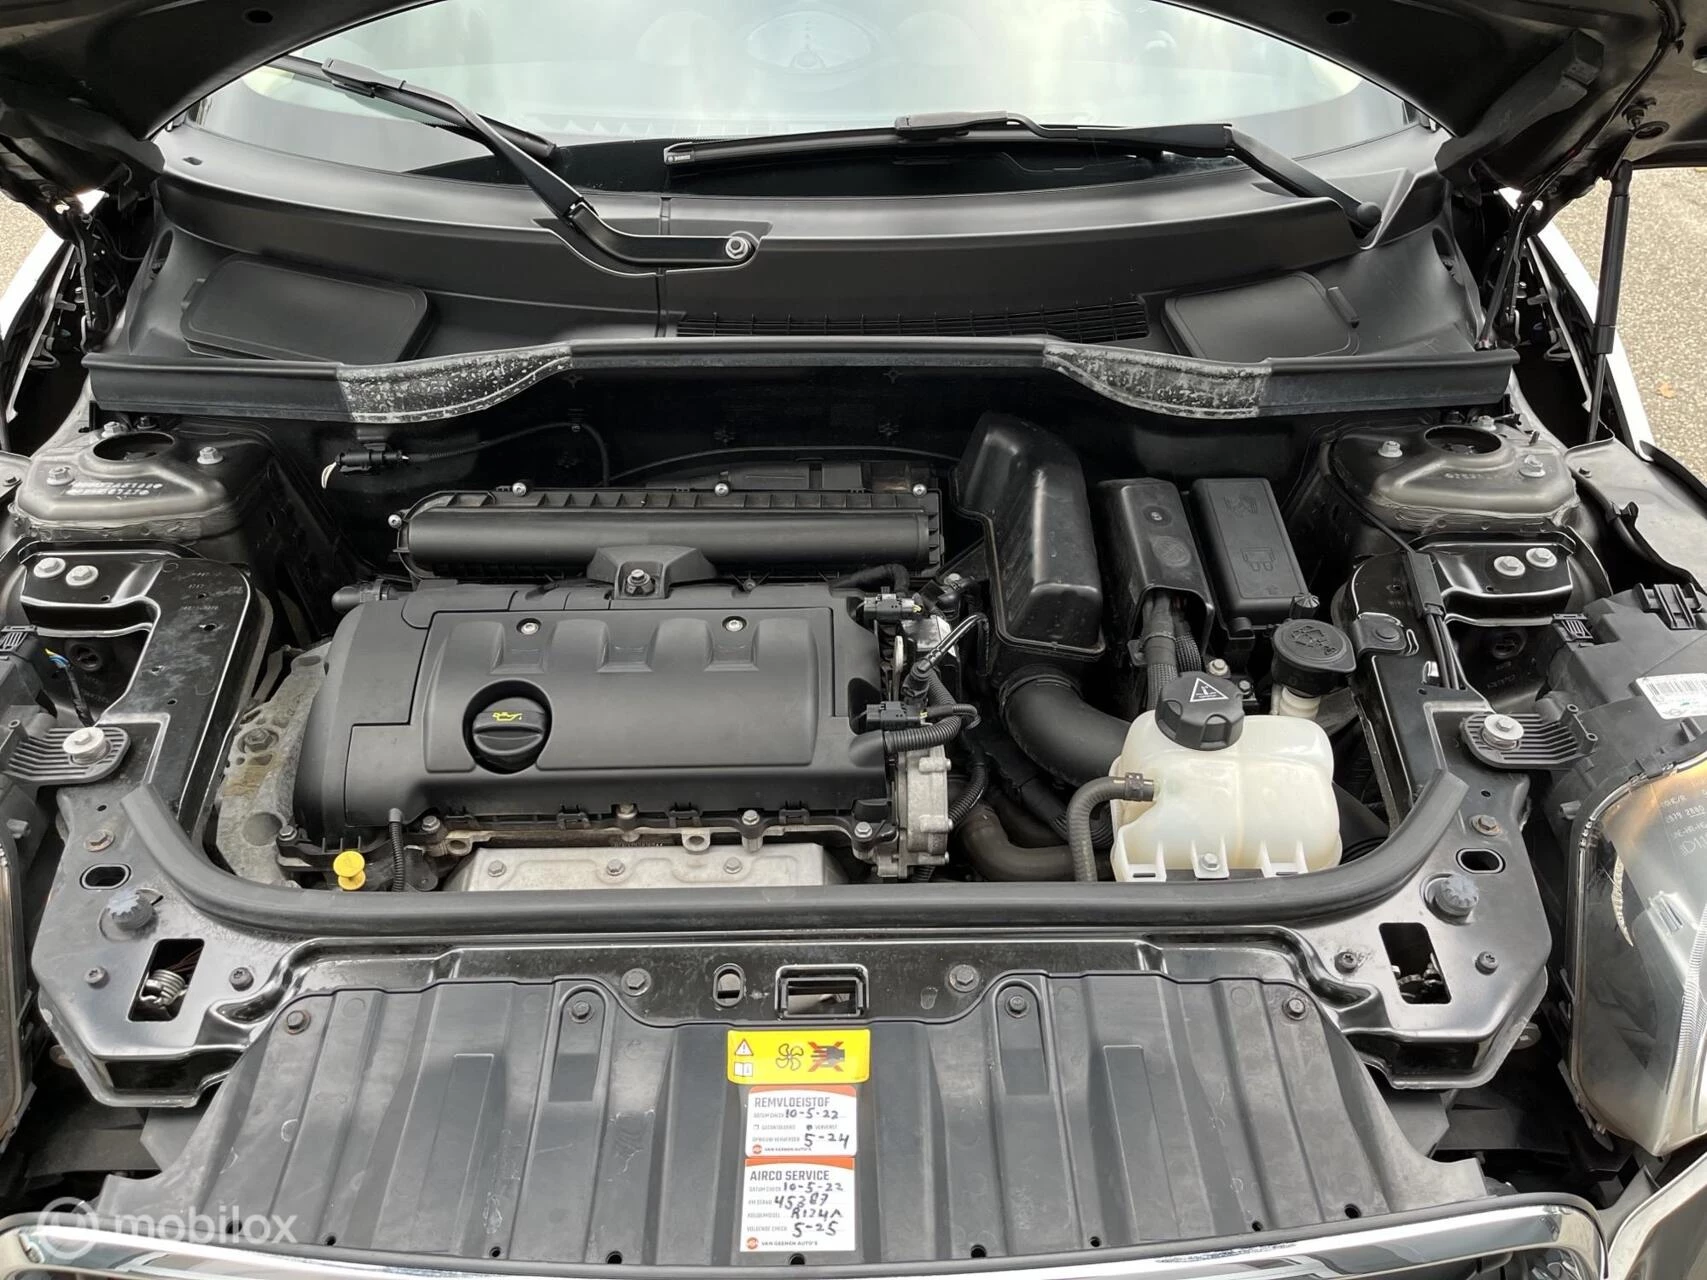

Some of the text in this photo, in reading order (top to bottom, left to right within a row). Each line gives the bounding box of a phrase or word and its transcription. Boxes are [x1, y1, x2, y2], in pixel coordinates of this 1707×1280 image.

[754, 1097, 830, 1108] REMVLOEISTOF
[804, 1133, 849, 1150] 5-24
[750, 1170, 829, 1181] AIRCO SERVICE
[784, 1181, 843, 1193] 10-5-22
[792, 1220, 838, 1238] 5-25
